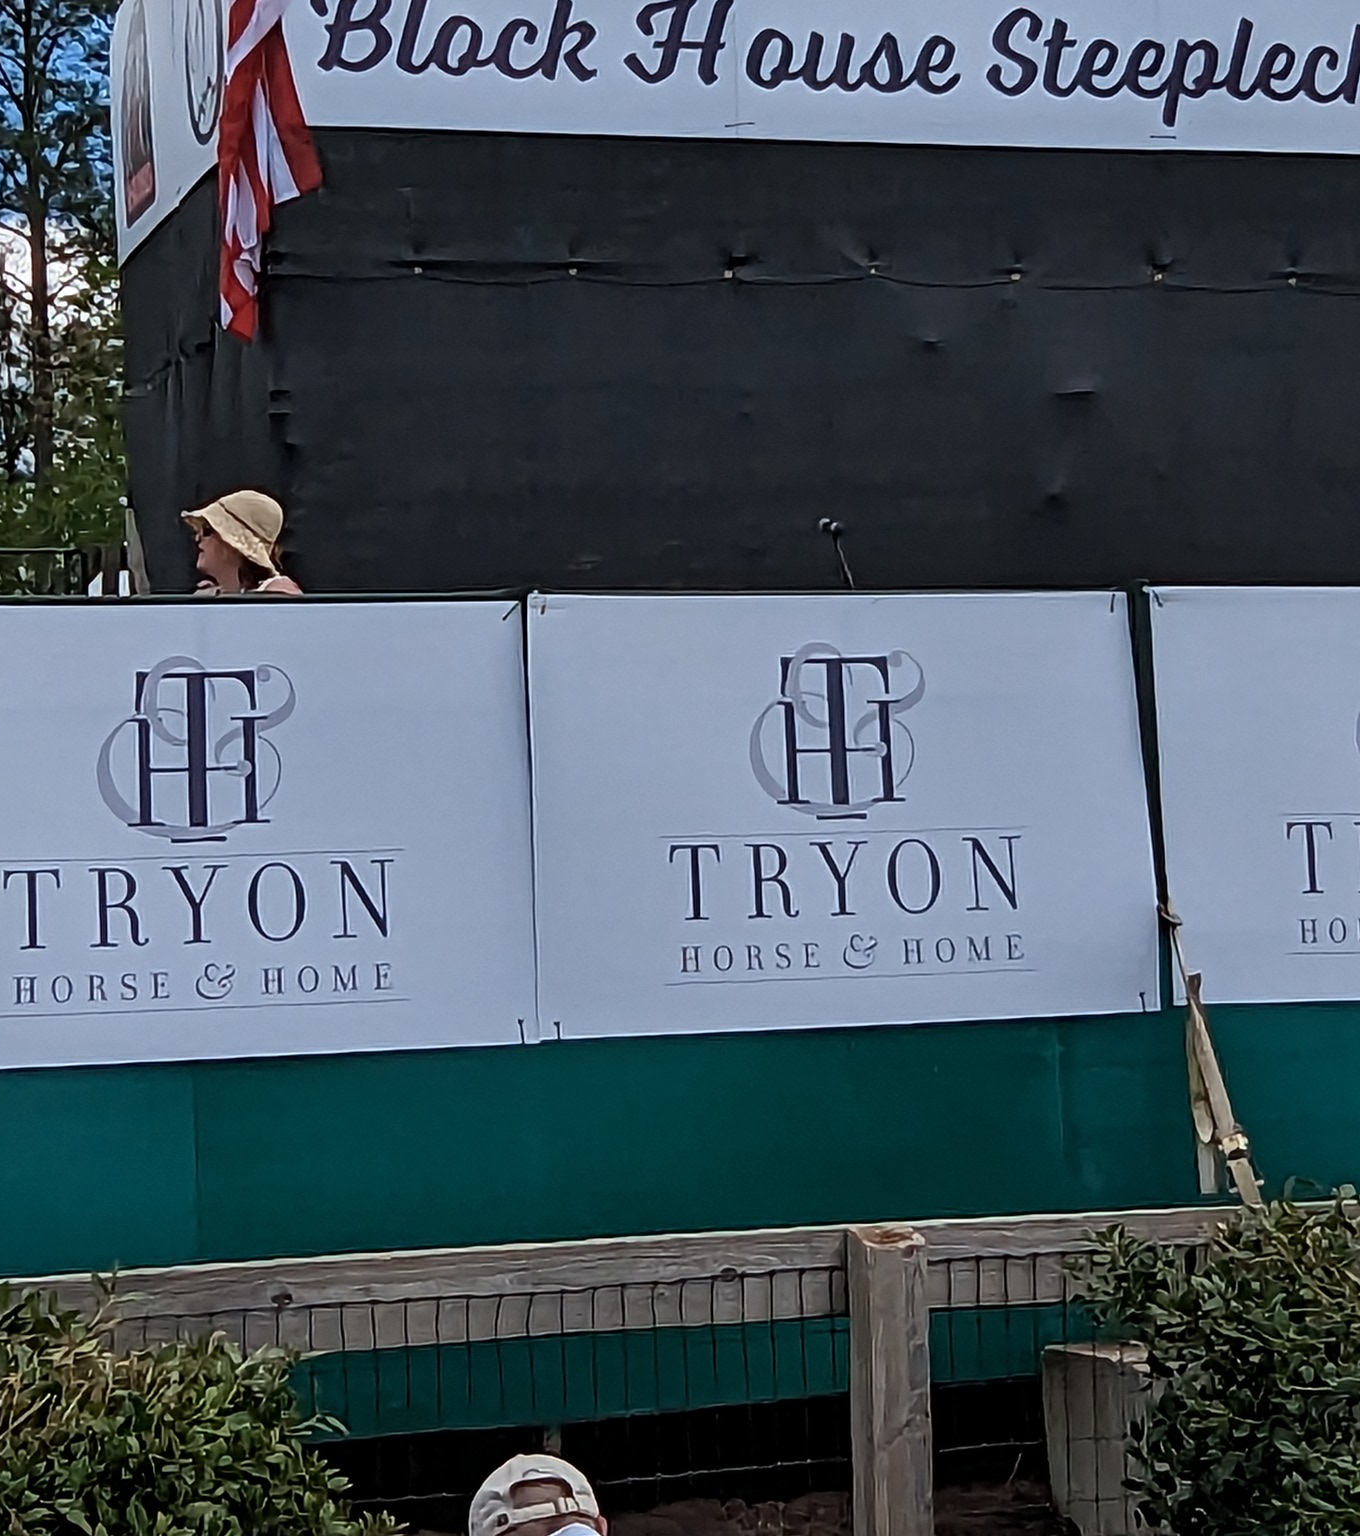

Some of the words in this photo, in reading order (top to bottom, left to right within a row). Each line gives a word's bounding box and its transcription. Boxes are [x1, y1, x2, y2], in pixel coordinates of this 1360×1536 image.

[2, 859, 394, 950] TRYON
[669, 836, 1021, 920] TRYON
[13, 972, 170, 1005] HORSE
[196, 963, 235, 1000] &
[261, 963, 394, 996] HOME
[681, 943, 820, 972] HORSE
[843, 934, 878, 969] &
[903, 934, 1024, 965] HOME
